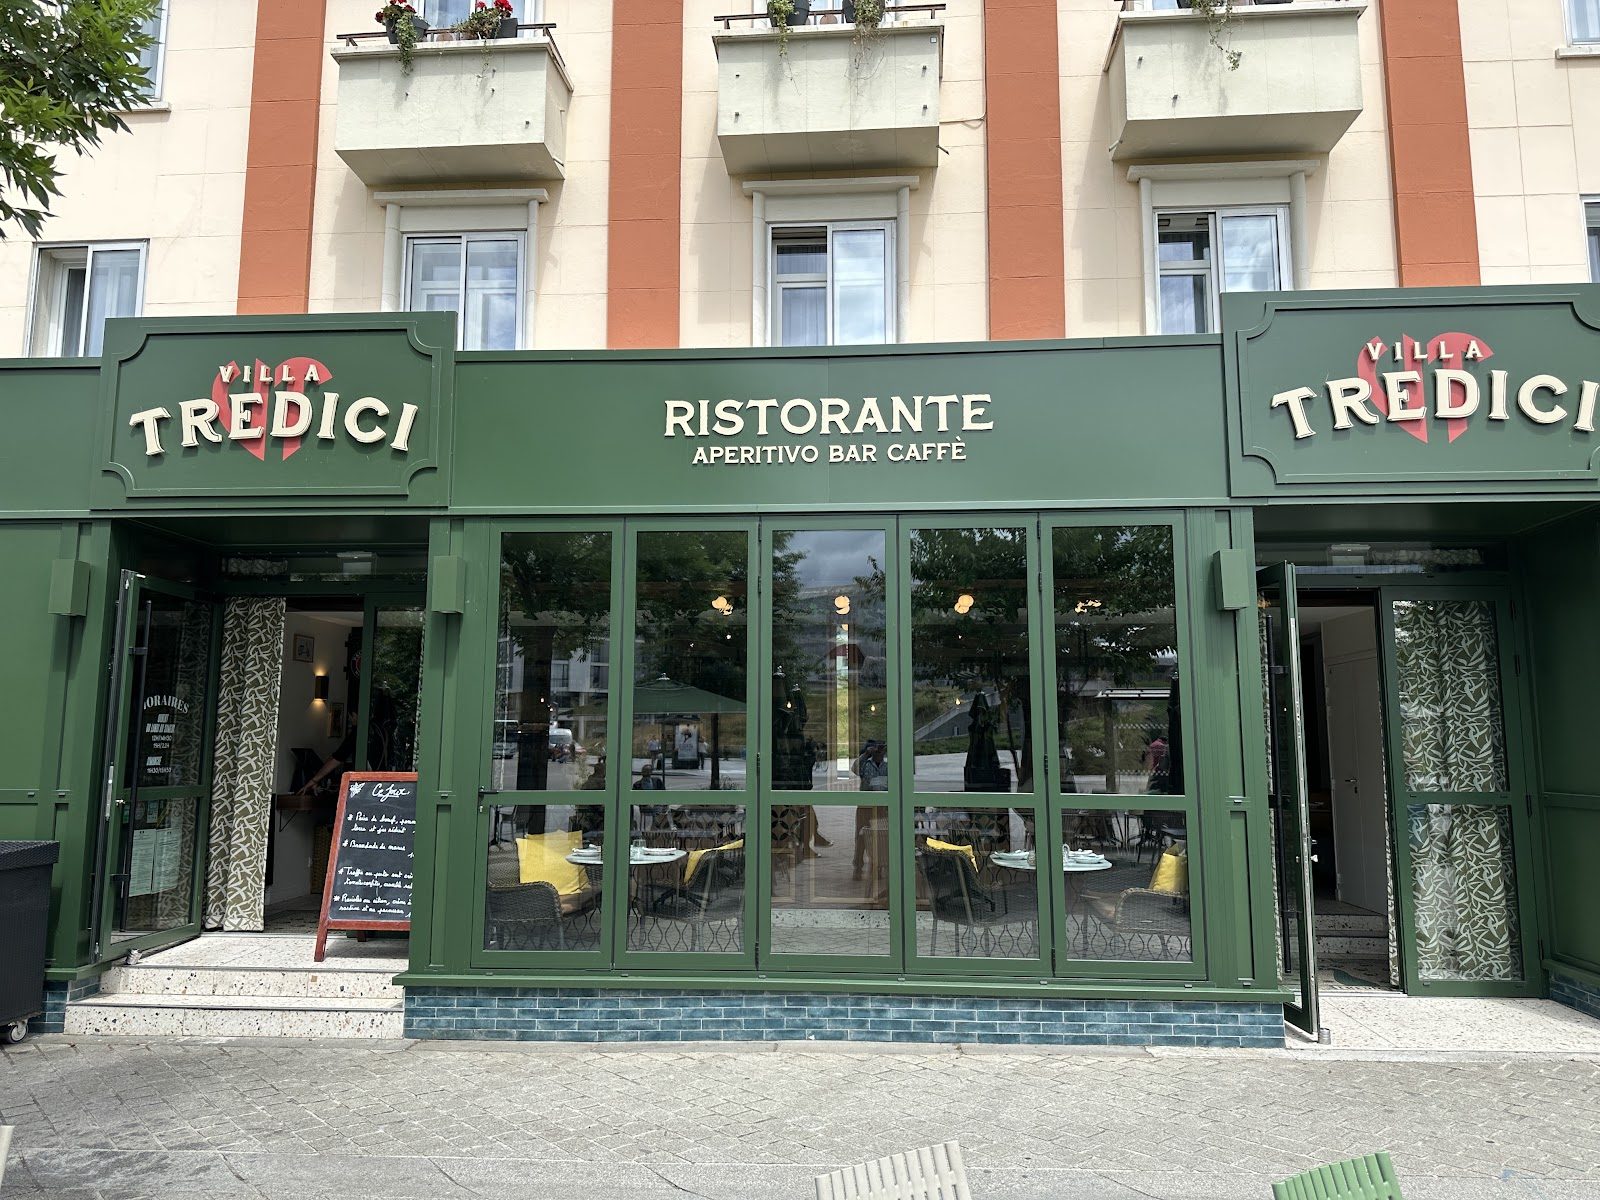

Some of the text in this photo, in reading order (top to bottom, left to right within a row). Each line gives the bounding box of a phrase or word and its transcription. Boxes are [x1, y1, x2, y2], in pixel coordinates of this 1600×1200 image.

[1365, 340, 1484, 361] VILLA
[219, 364, 320, 383] VILLA
[664, 393, 995, 437] RISTORANTE
[1271, 369, 1600, 440] TREDICI
[128, 391, 419, 456] TREDICI
[692, 436, 967, 465] APERITIVO BAR CAFFÈ
